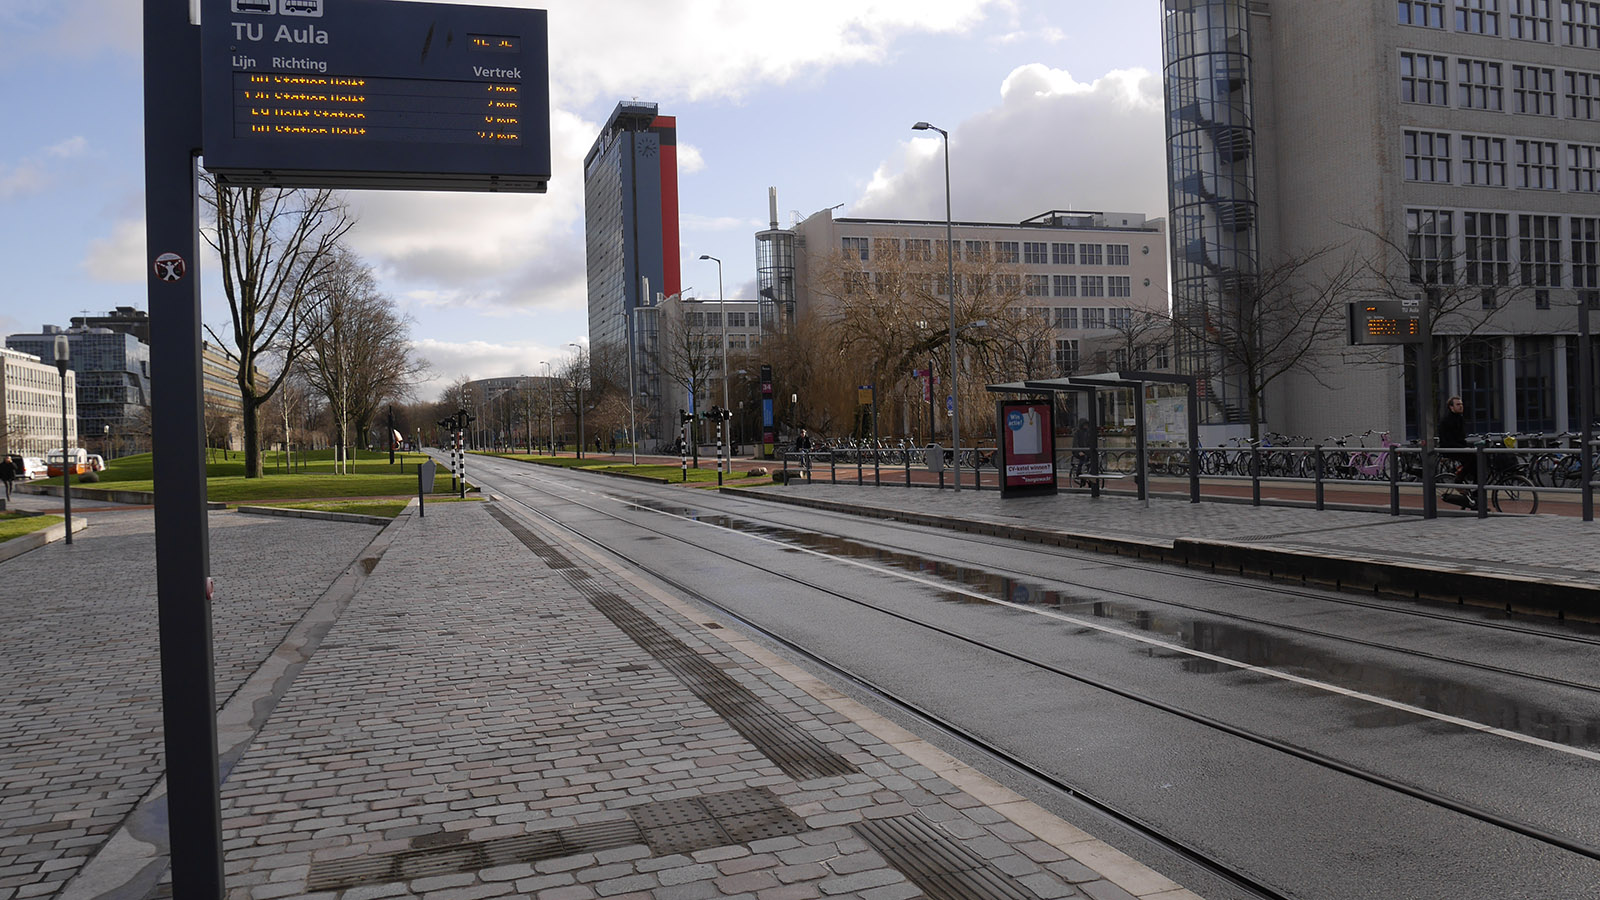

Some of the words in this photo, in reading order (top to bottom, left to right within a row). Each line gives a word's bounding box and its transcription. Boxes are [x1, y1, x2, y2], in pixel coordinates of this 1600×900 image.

[231, 22, 264, 42] TU
[274, 24, 329, 45] Aula
[232, 55, 257, 69] Lijn
[272, 57, 328, 73] Richting
[473, 66, 522, 79] Vertrek
